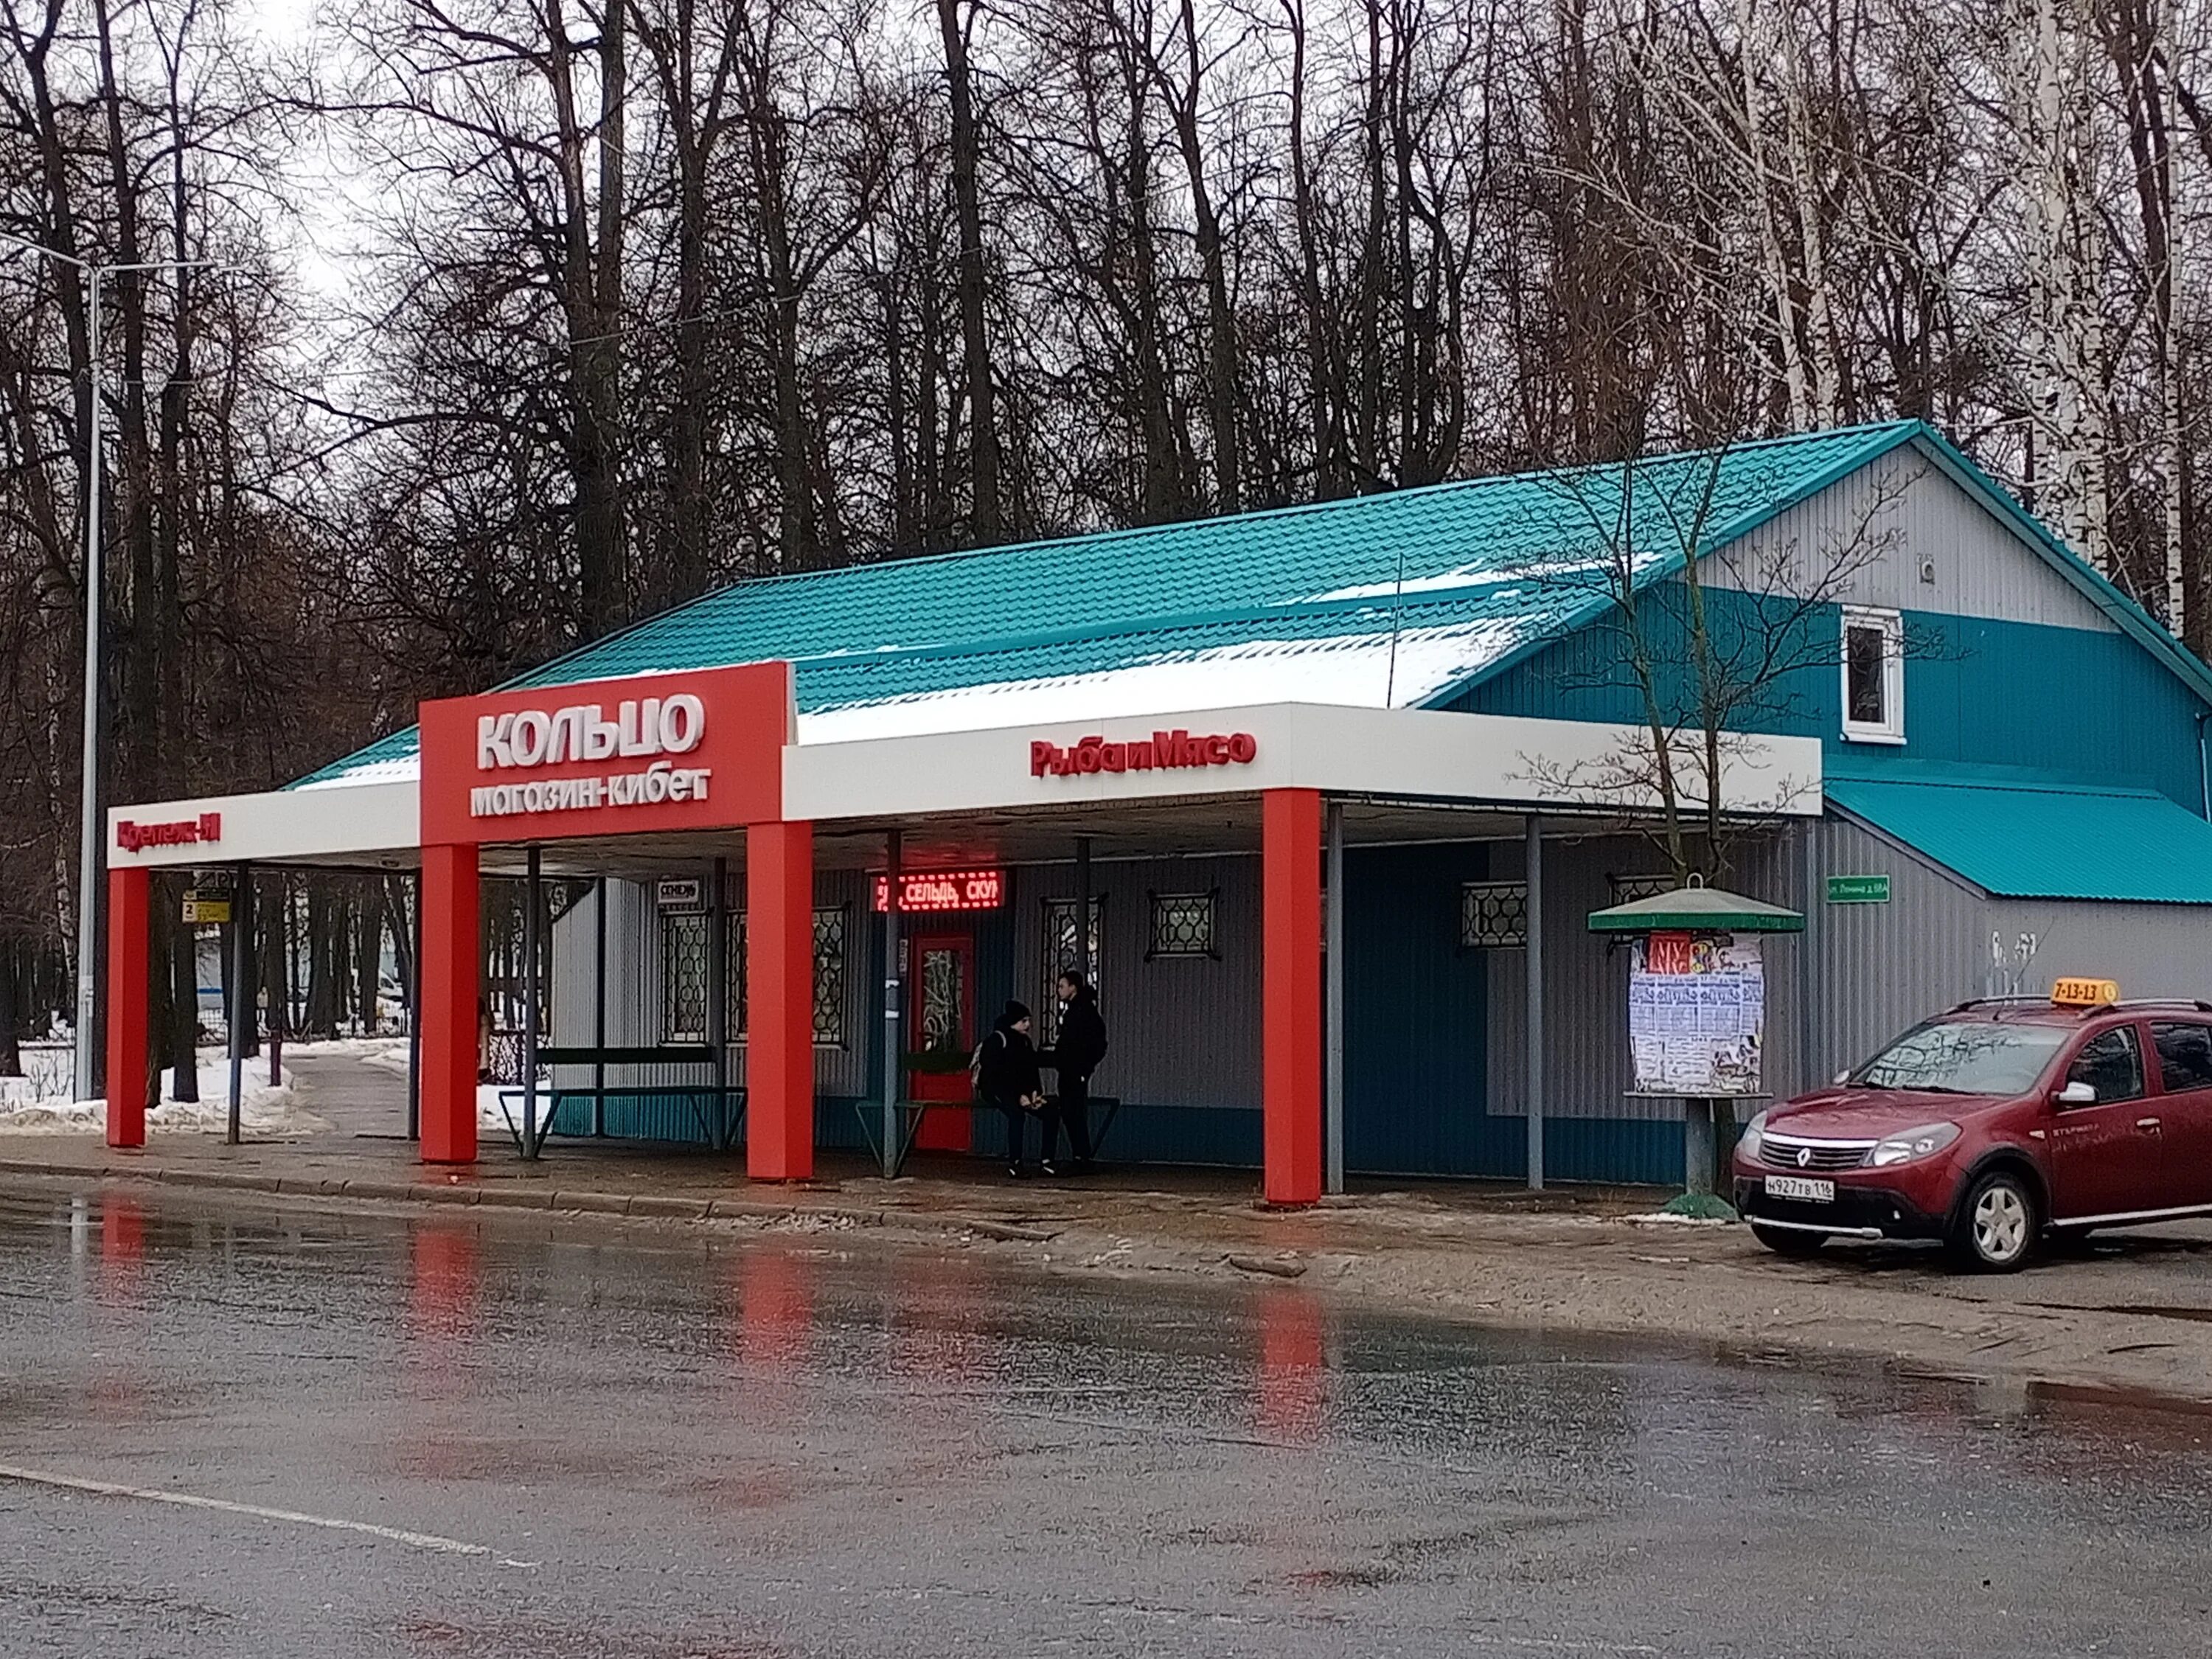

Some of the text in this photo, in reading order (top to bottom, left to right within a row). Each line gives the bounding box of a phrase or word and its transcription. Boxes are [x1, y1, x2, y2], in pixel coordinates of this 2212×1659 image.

[477, 693, 704, 770] КОЛЬЦО
[470, 760, 711, 817] магазин-кибет
[186, 904, 193, 914] 2
